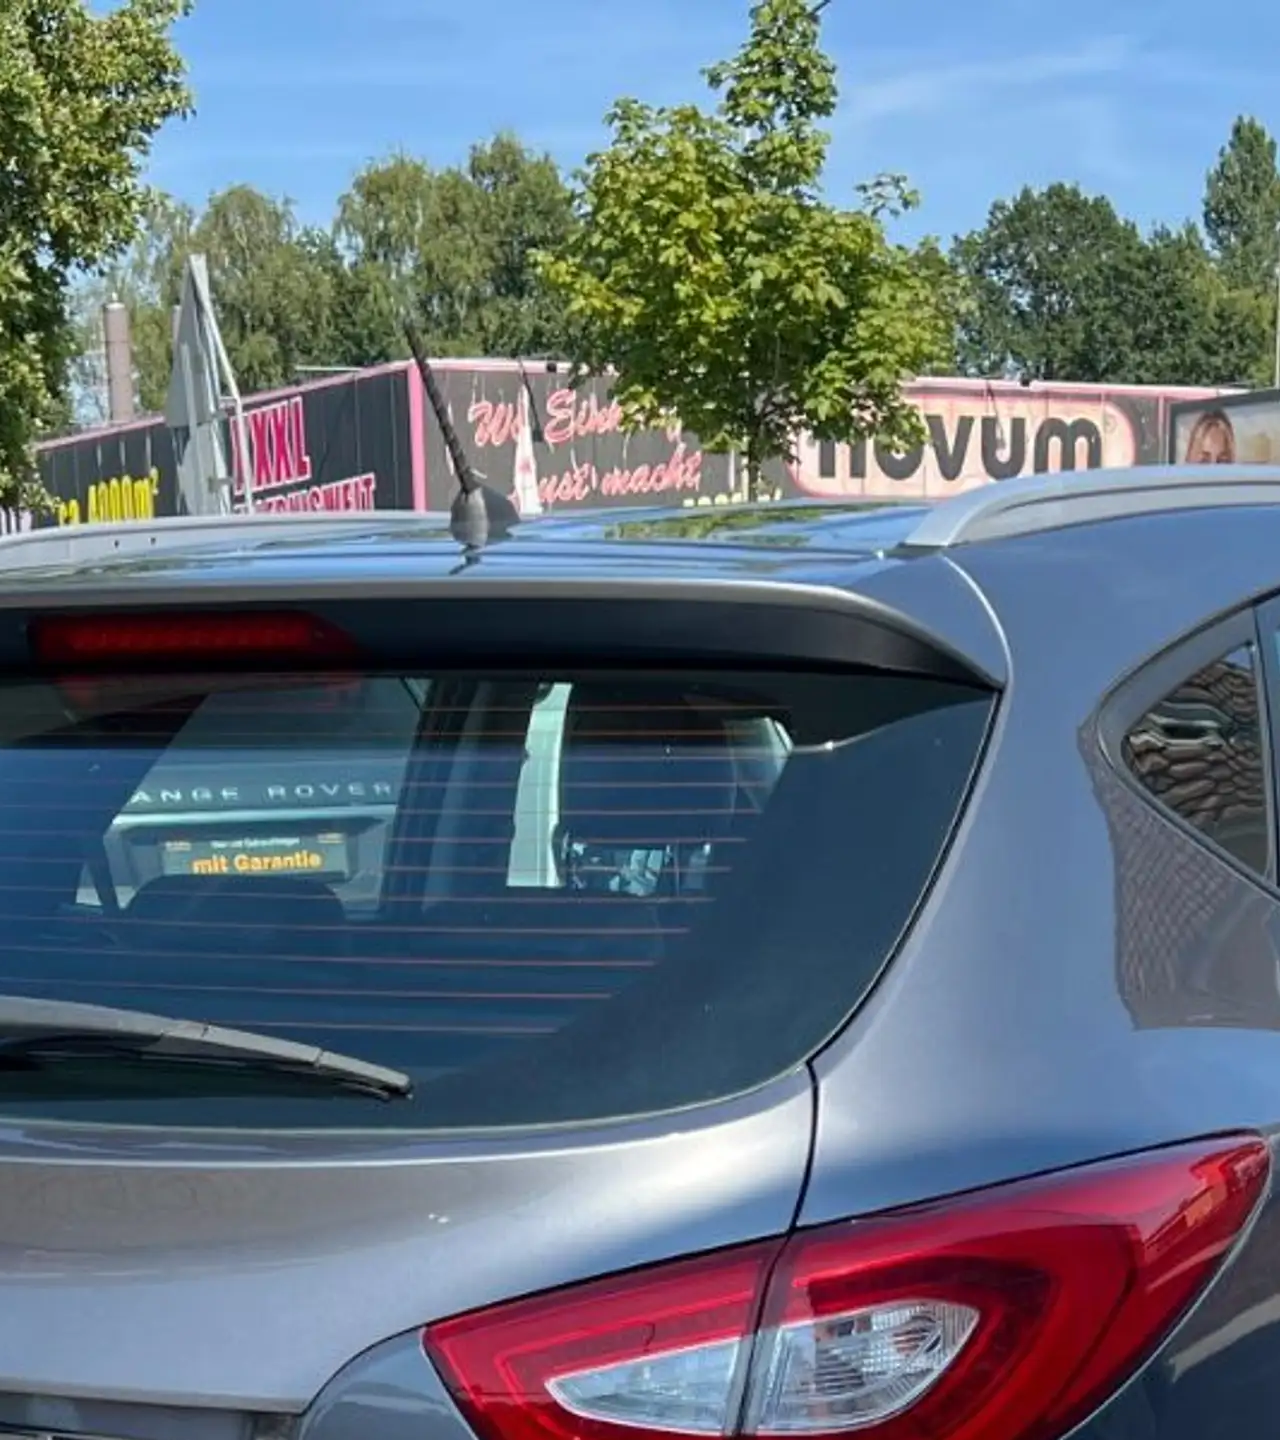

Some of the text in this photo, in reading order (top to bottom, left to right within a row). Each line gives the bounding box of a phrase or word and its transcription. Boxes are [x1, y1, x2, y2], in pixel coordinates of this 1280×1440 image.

[819, 415, 1102, 481] novum
[267, 781, 392, 799] ROVER
[191, 849, 323, 875] mit Garantie
